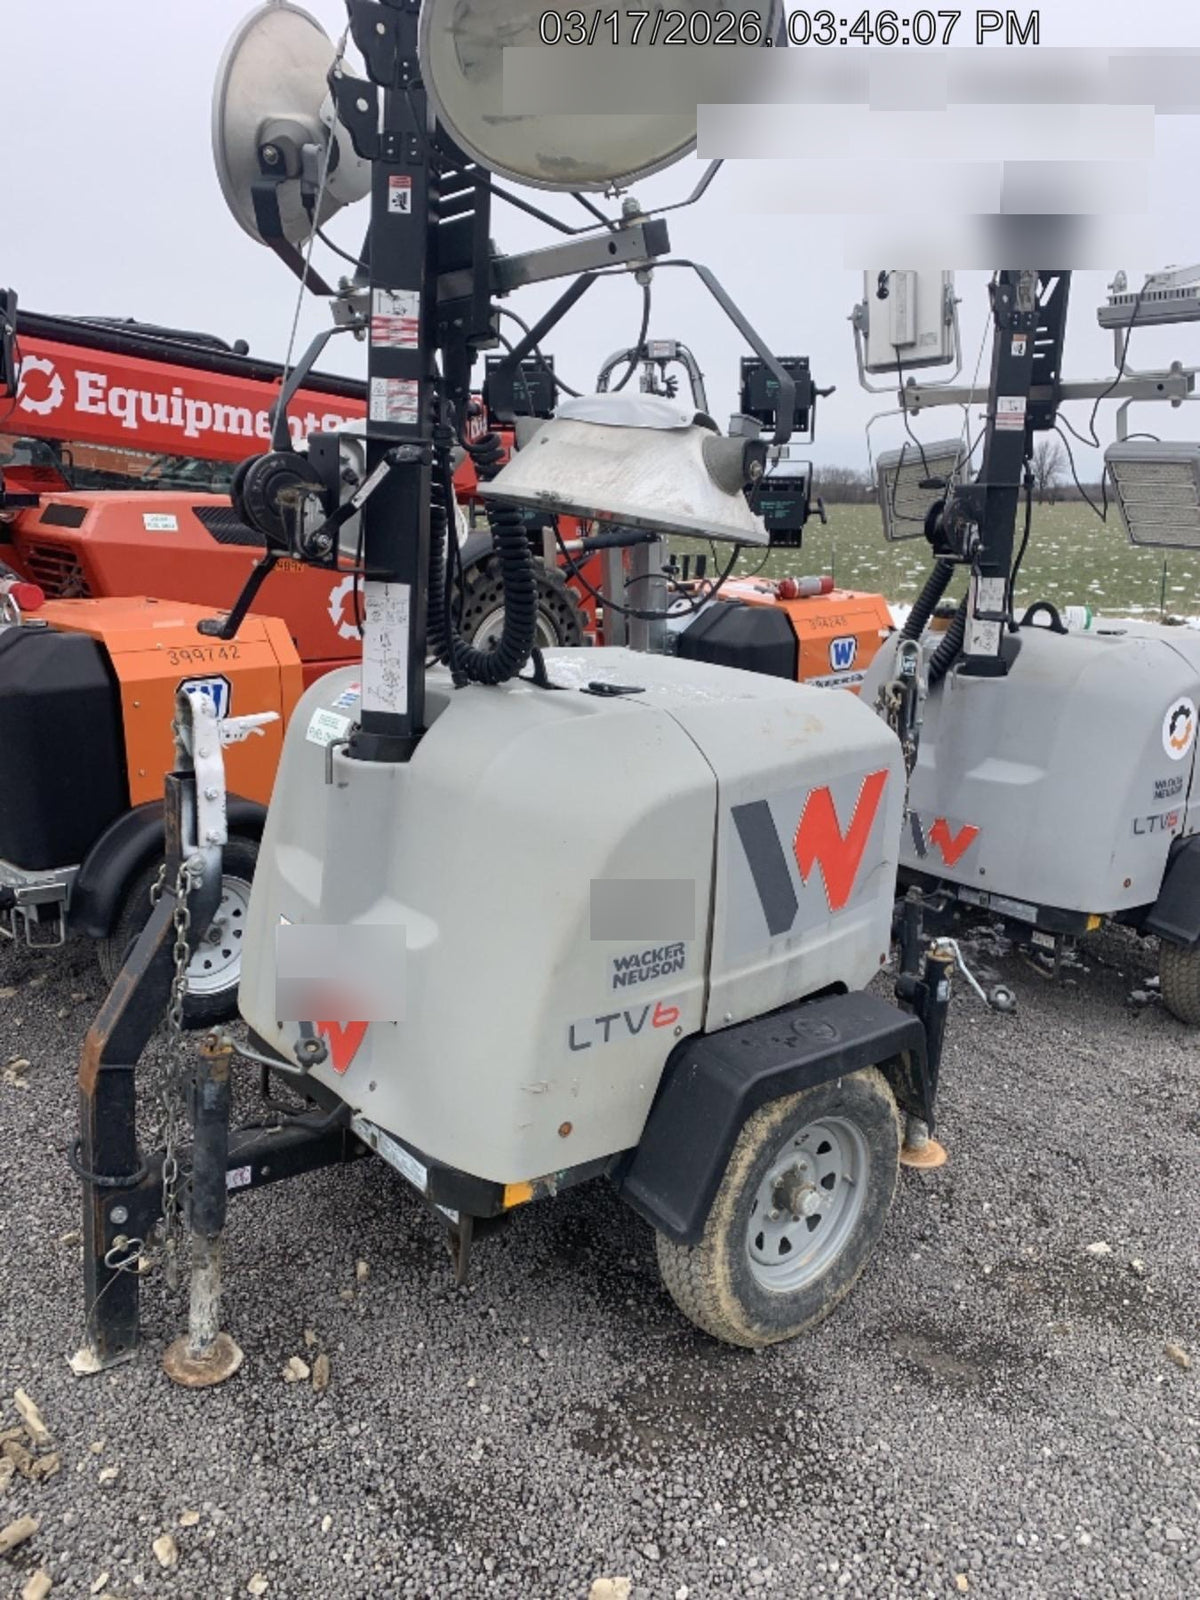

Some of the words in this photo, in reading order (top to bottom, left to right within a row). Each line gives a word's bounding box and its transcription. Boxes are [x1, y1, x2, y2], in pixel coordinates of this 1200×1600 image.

[167, 645, 240, 666] 399742
[833, 641, 854, 666] W
[612, 942, 686, 972] WACKER
[612, 957, 686, 989] NEUSON
[568, 1001, 680, 1052] LTV6
